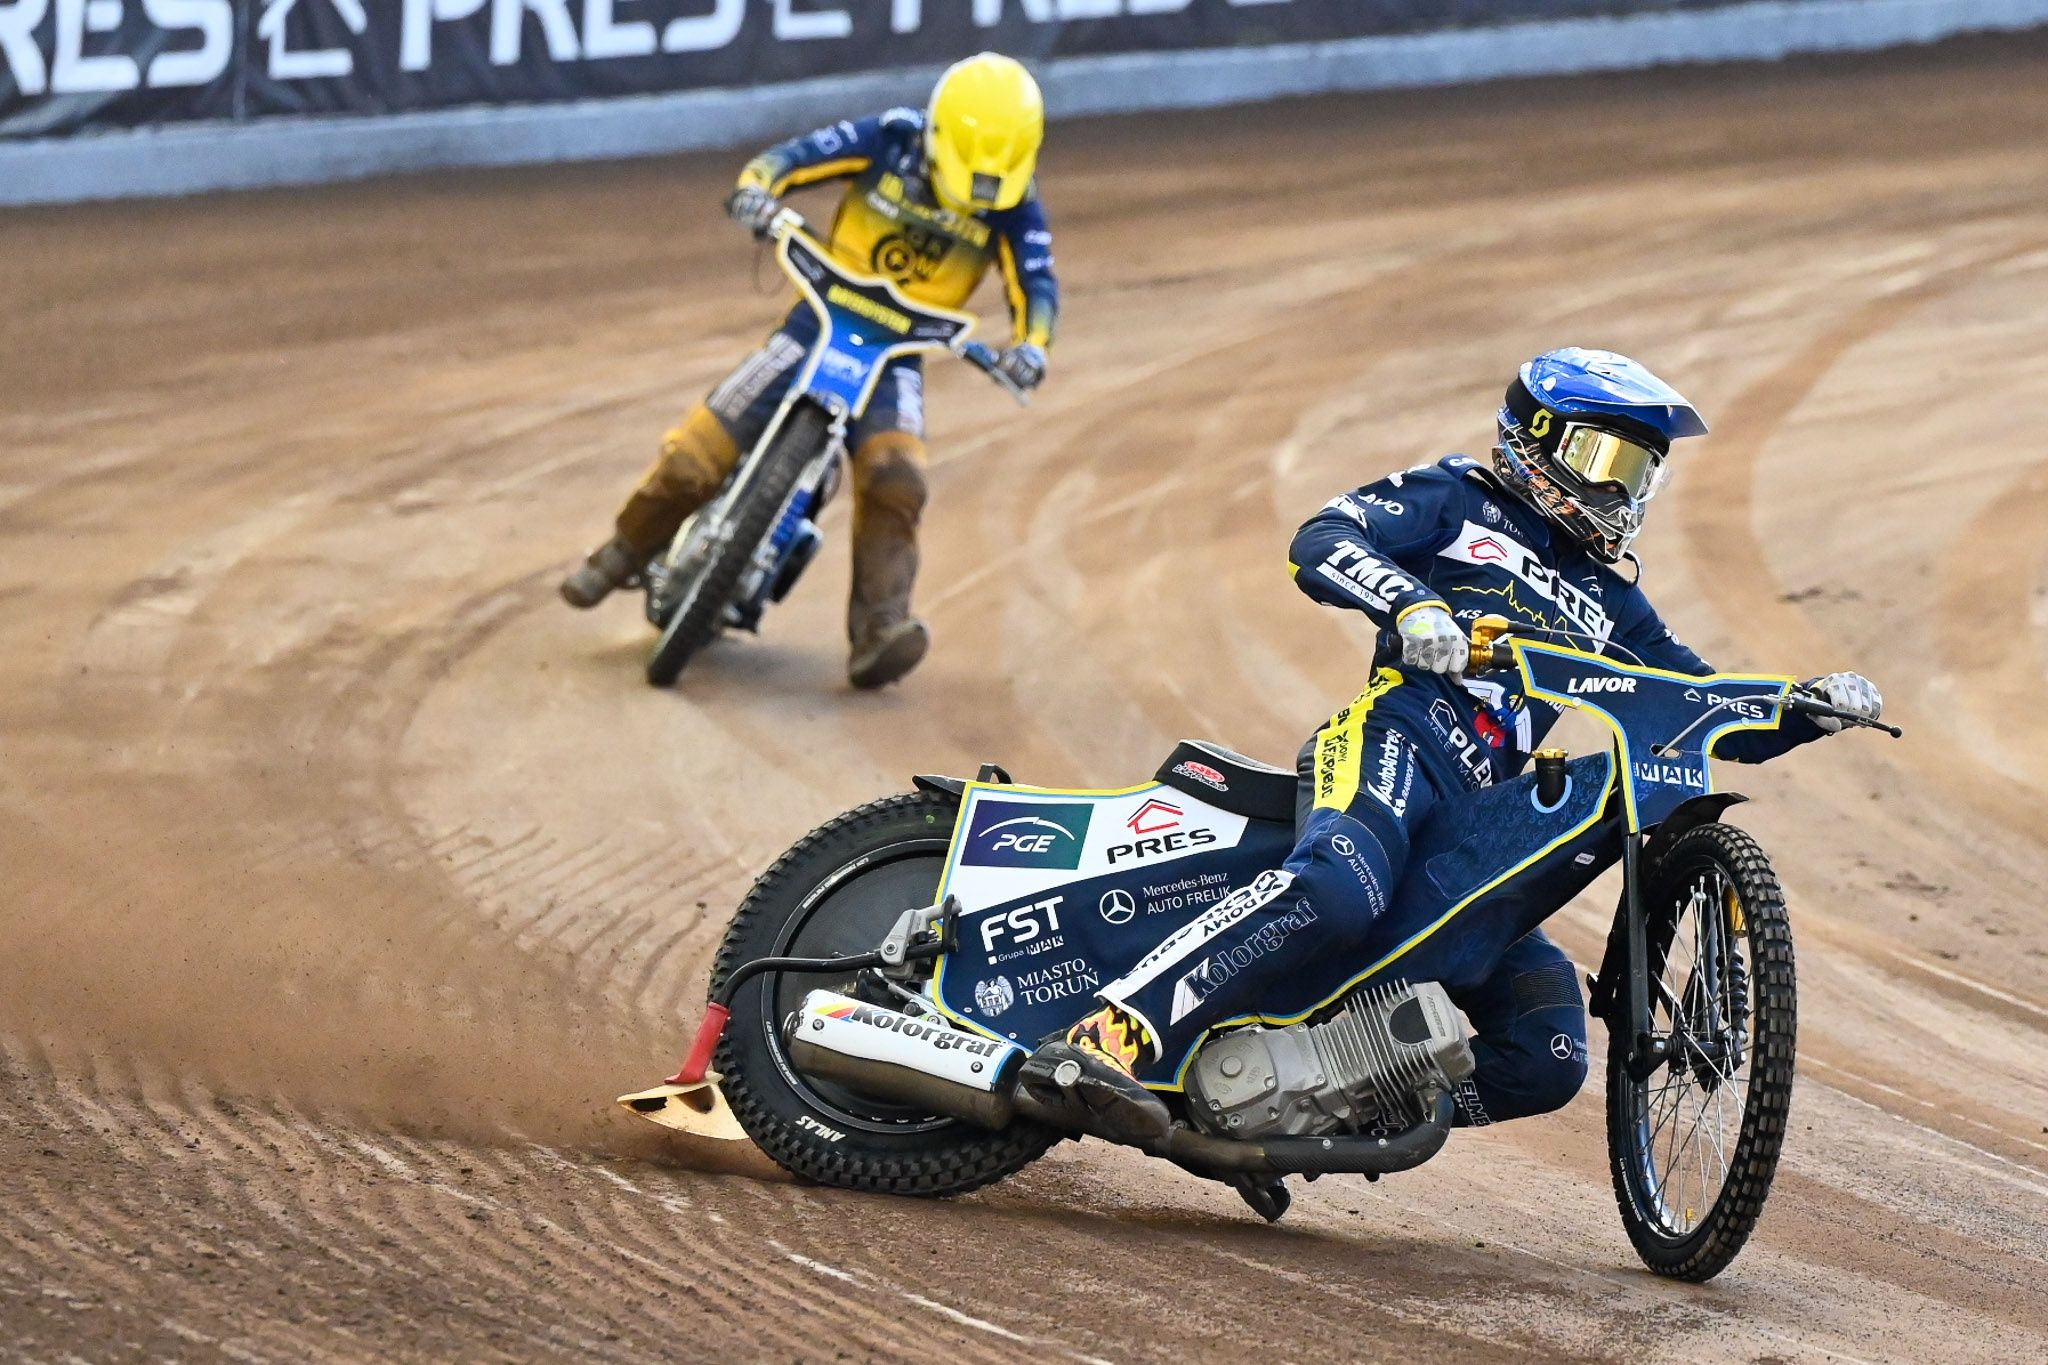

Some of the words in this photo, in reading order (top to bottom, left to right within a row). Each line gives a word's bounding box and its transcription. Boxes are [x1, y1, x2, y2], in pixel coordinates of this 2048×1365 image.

[1327, 540, 1414, 603] TMC
[1331, 572, 1356, 593] since
[1521, 556, 1605, 641] PRE
[1567, 678, 1637, 693] LAVOR
[1707, 693, 1764, 719] PRES
[992, 834, 1056, 853] PGE
[1106, 828, 1217, 864] PRES
[1142, 872, 1229, 898] Mercedes-Benz
[1147, 896, 1184, 915] AUTO
[1186, 885, 1232, 906] FRELIK
[1347, 858, 1368, 884] AUTO
[1364, 884, 1380, 920] FRELIK
[980, 895, 1064, 952] FST
[1203, 899, 1257, 937] DOMY
[998, 949, 1025, 962] Grupa
[1184, 897, 1318, 1001] Kolorgraf
[1017, 958, 1086, 988] MIASTO
[1020, 967, 1099, 1005] TORUŃ
[851, 1005, 1003, 1058] Kolorgraf
[795, 1115, 846, 1142] ANLAS
